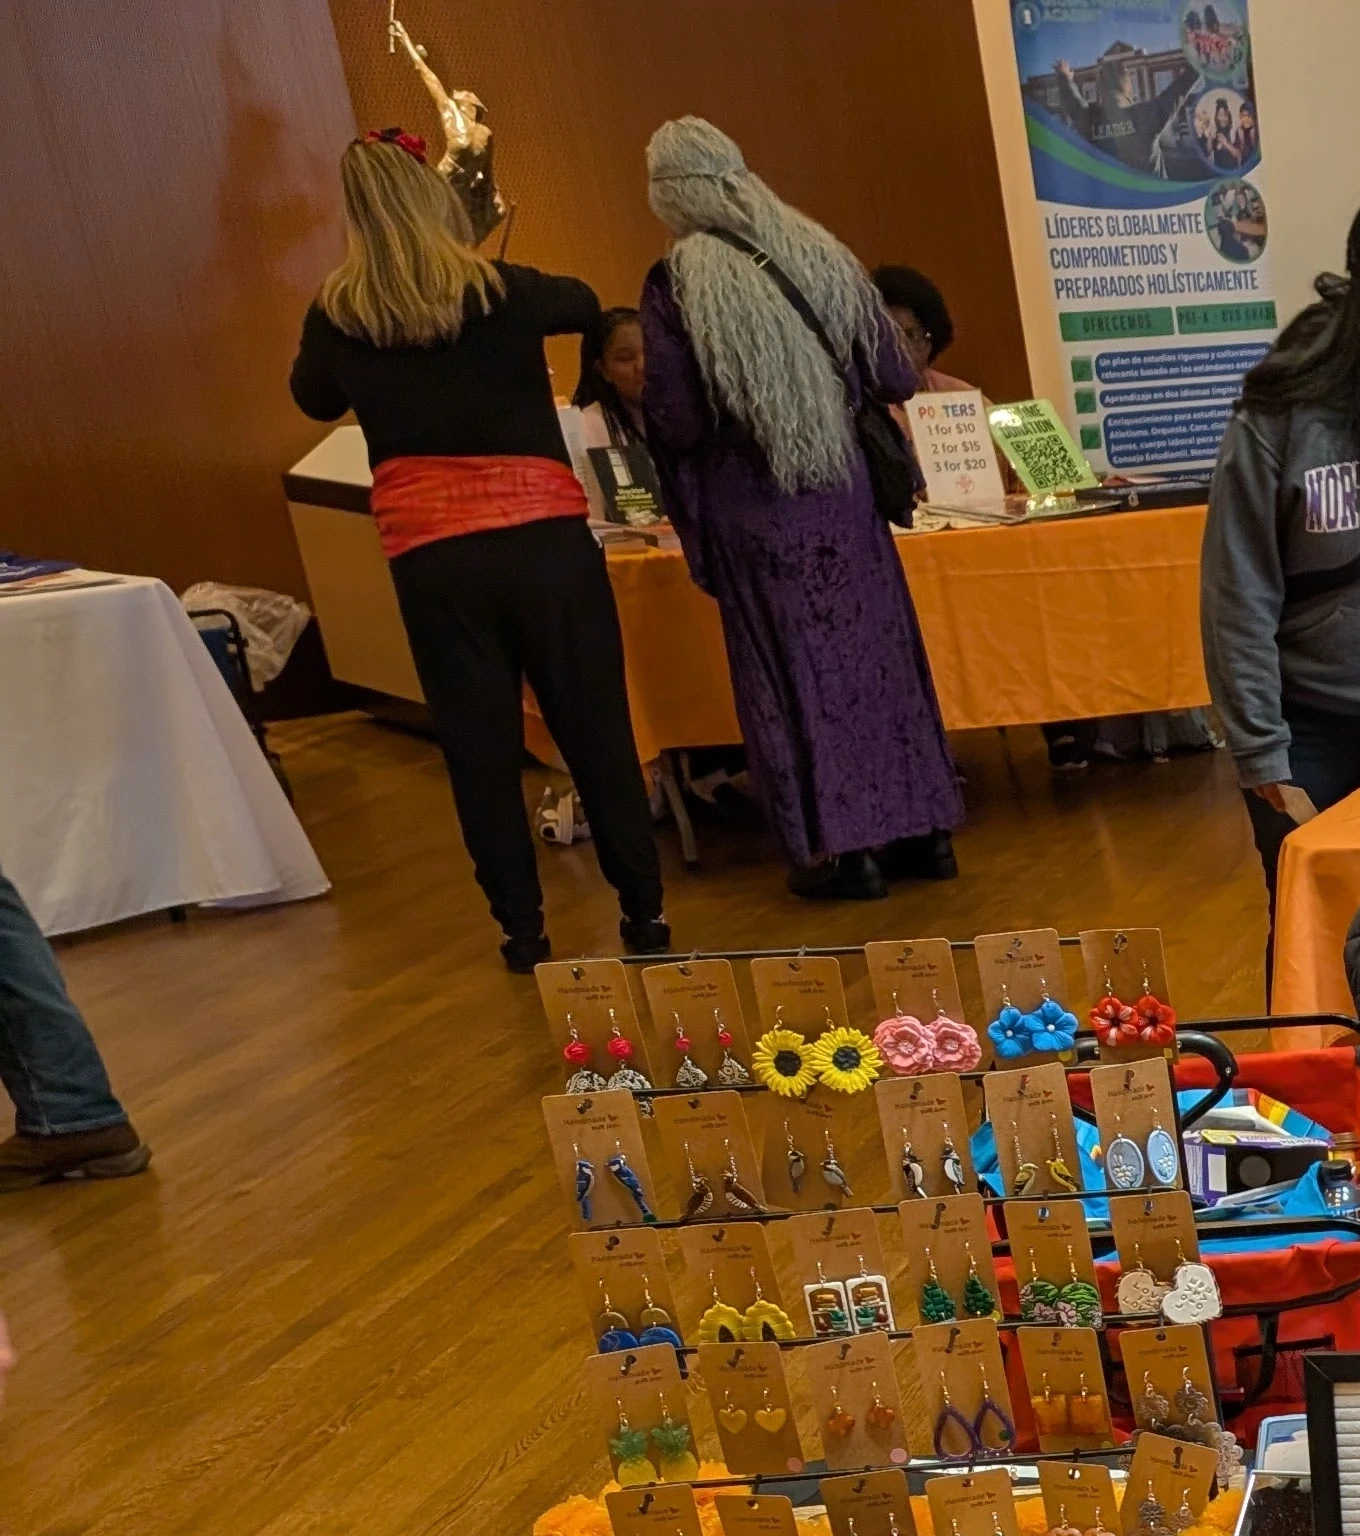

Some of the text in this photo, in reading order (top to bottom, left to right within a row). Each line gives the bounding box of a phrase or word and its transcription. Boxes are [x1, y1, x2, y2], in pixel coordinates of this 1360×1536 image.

[1045, 213, 1203, 239] LÍDERES GLOBALMENTE
[1050, 243, 1179, 269] COMPROMETIDOS Y
[1054, 269, 1259, 299] PREPARADOS HOLÍSTICAMENTE
[1082, 314, 1152, 333] OFRECEMOS
[918, 403, 976, 419] POTERS
[927, 422, 976, 435] 1 for $10
[931, 440, 981, 455] 2 for $15
[934, 458, 987, 472] 3 for $20
